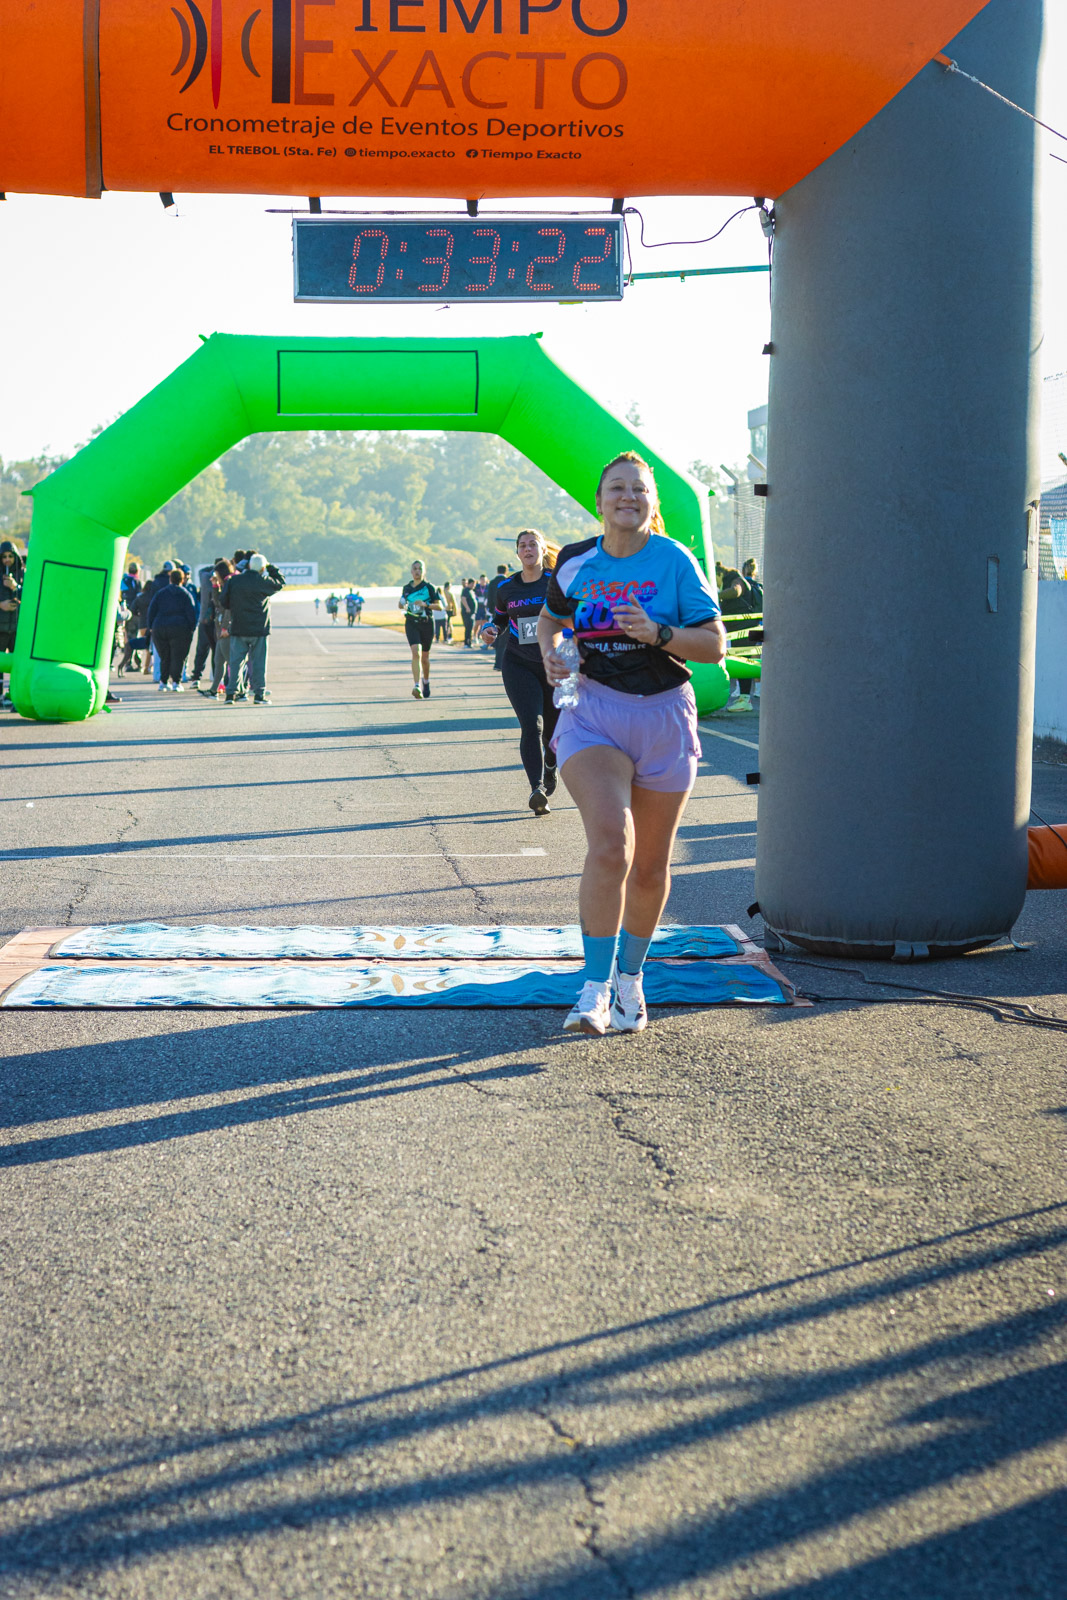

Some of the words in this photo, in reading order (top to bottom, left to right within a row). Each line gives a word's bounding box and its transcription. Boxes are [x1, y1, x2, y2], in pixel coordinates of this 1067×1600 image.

[166, 112, 335, 138] Cronometraje
[342, 116, 373, 135] de
[381, 117, 478, 136] Eventos
[486, 118, 624, 141] Deportivos
[209, 145, 225, 154] EL
[227, 145, 280, 156] TREBOL
[283, 146, 313, 157] (Sta.
[317, 147, 338, 157] Fe)
[359, 148, 456, 160] tiempo.exacto
[480, 149, 535, 160] Tiempo
[536, 150, 582, 160] Exacto
[348, 228, 613, 292] 0:33:22
